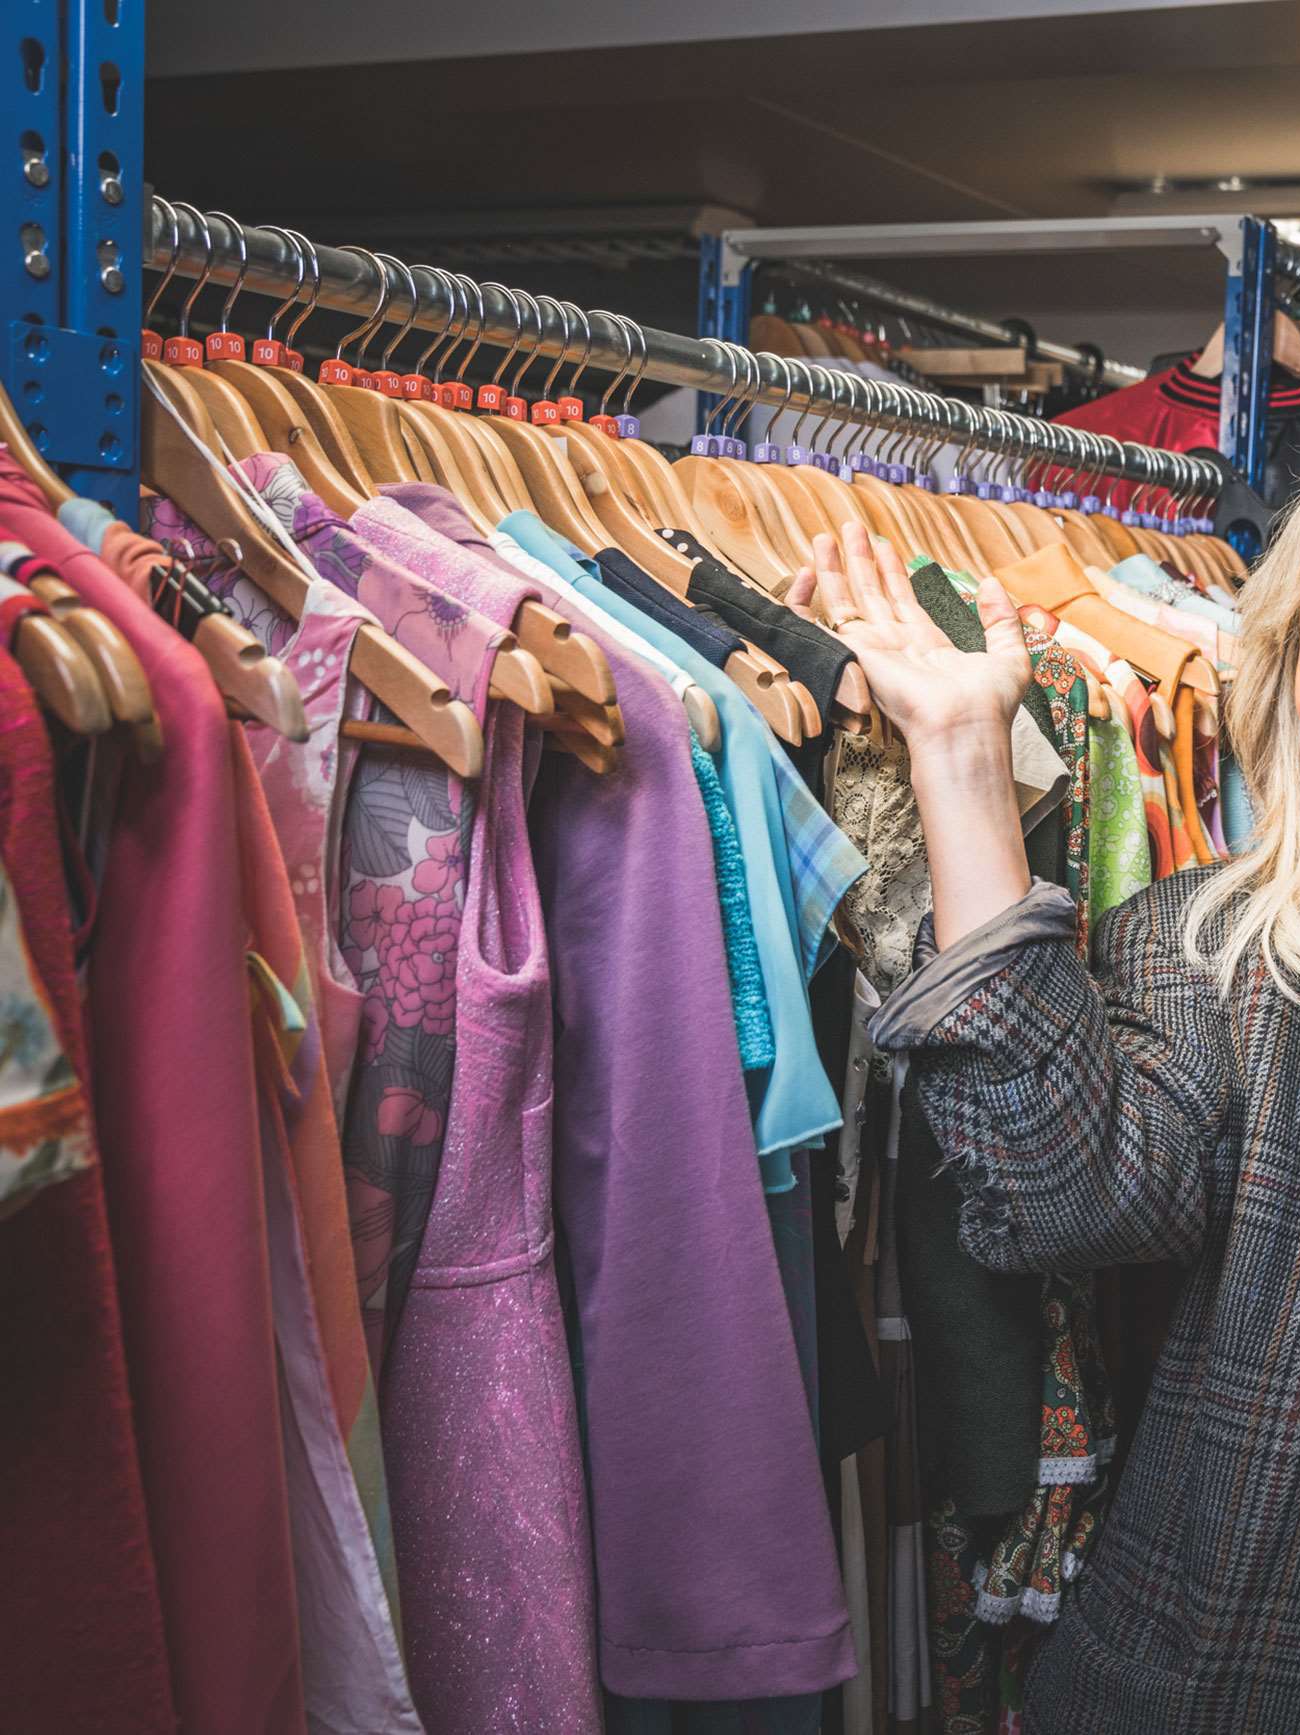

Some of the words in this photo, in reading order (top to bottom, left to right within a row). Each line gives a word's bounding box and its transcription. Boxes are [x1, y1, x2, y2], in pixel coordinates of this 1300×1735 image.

[146, 342, 158, 356] 10
[210, 338, 222, 350] 10
[228, 340, 241, 353] 10
[168, 346, 178, 358] 10
[186, 346, 199, 360] 10
[258, 347, 273, 360] 10
[290, 360, 300, 372] 10
[334, 368, 348, 381] 10
[362, 378, 372, 389] 10
[388, 376, 399, 389] 10
[405, 380, 417, 392] 10
[460, 390, 470, 400] 10
[482, 392, 496, 404] 10
[544, 408, 556, 420] 10
[566, 406, 579, 416] 10
[608, 423, 616, 434] 10
[628, 423, 635, 435] 8
[696, 440, 704, 452] 8
[727, 442, 733, 454] 8
[792, 450, 800, 460] 8
